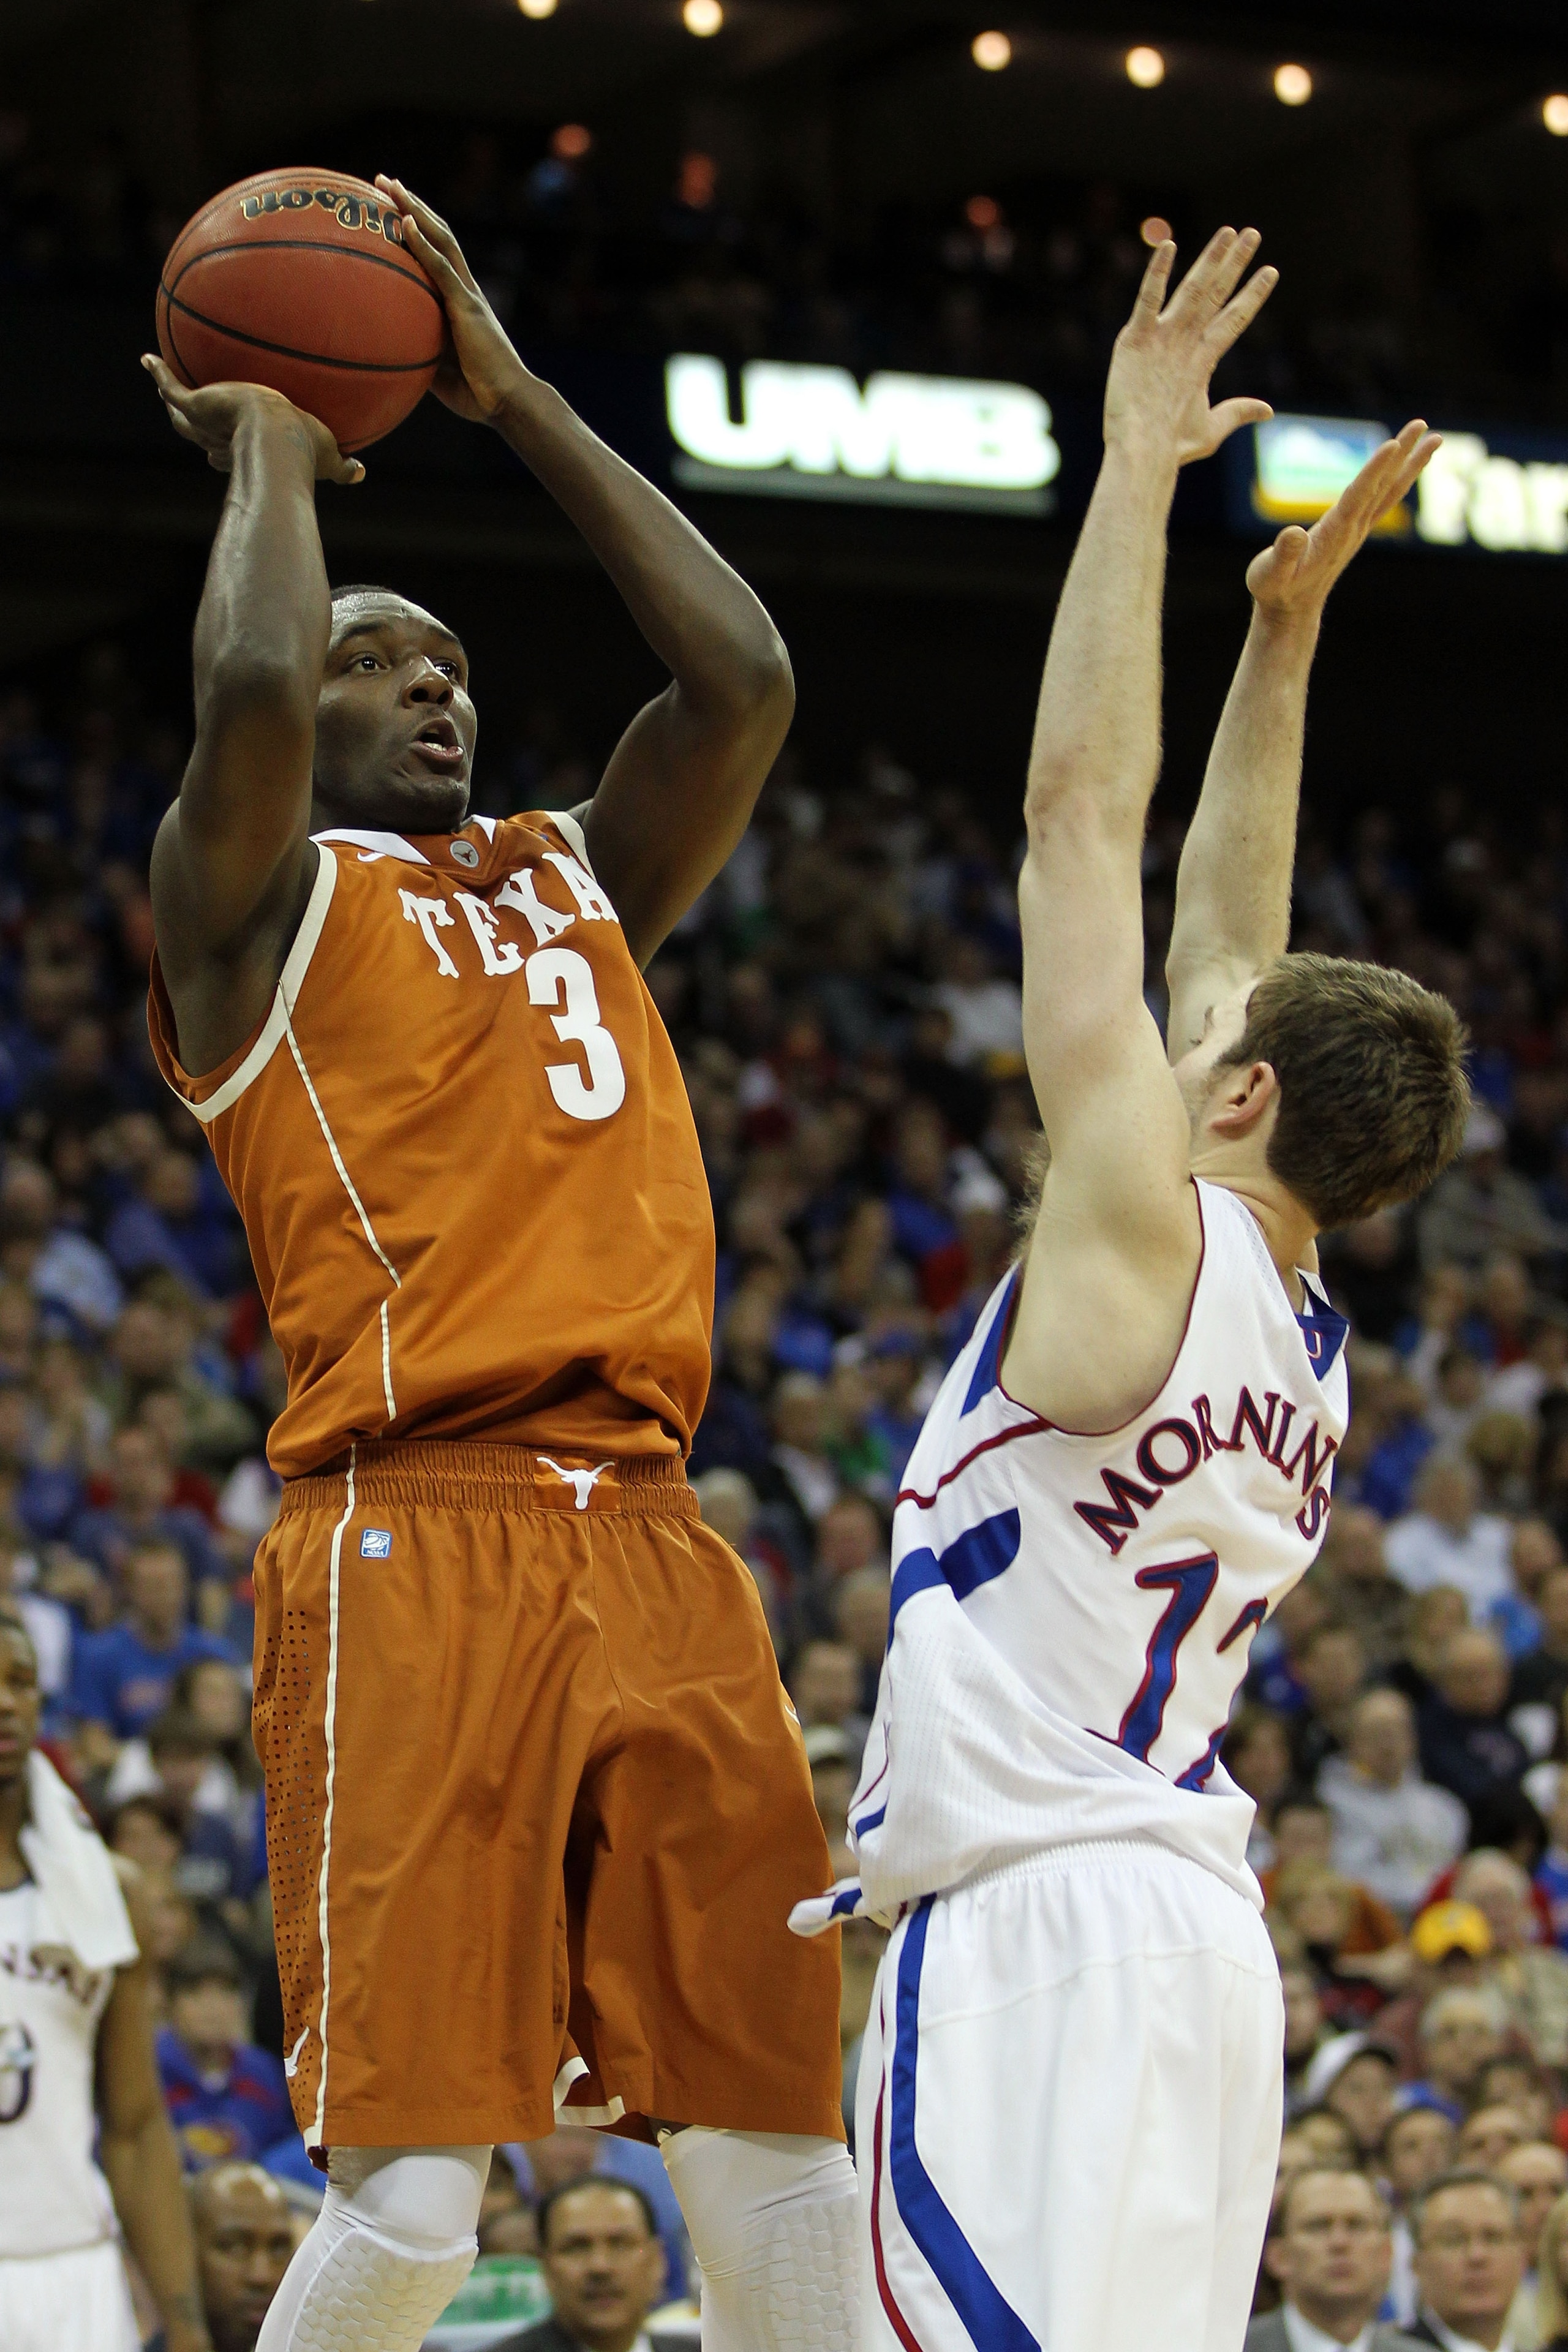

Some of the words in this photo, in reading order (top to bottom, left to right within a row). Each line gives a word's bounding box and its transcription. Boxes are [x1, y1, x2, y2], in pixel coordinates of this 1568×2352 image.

[665, 352, 1061, 490] UMB
[524, 947, 626, 1121] 3
[1073, 1384, 1338, 1556] MORNINS
